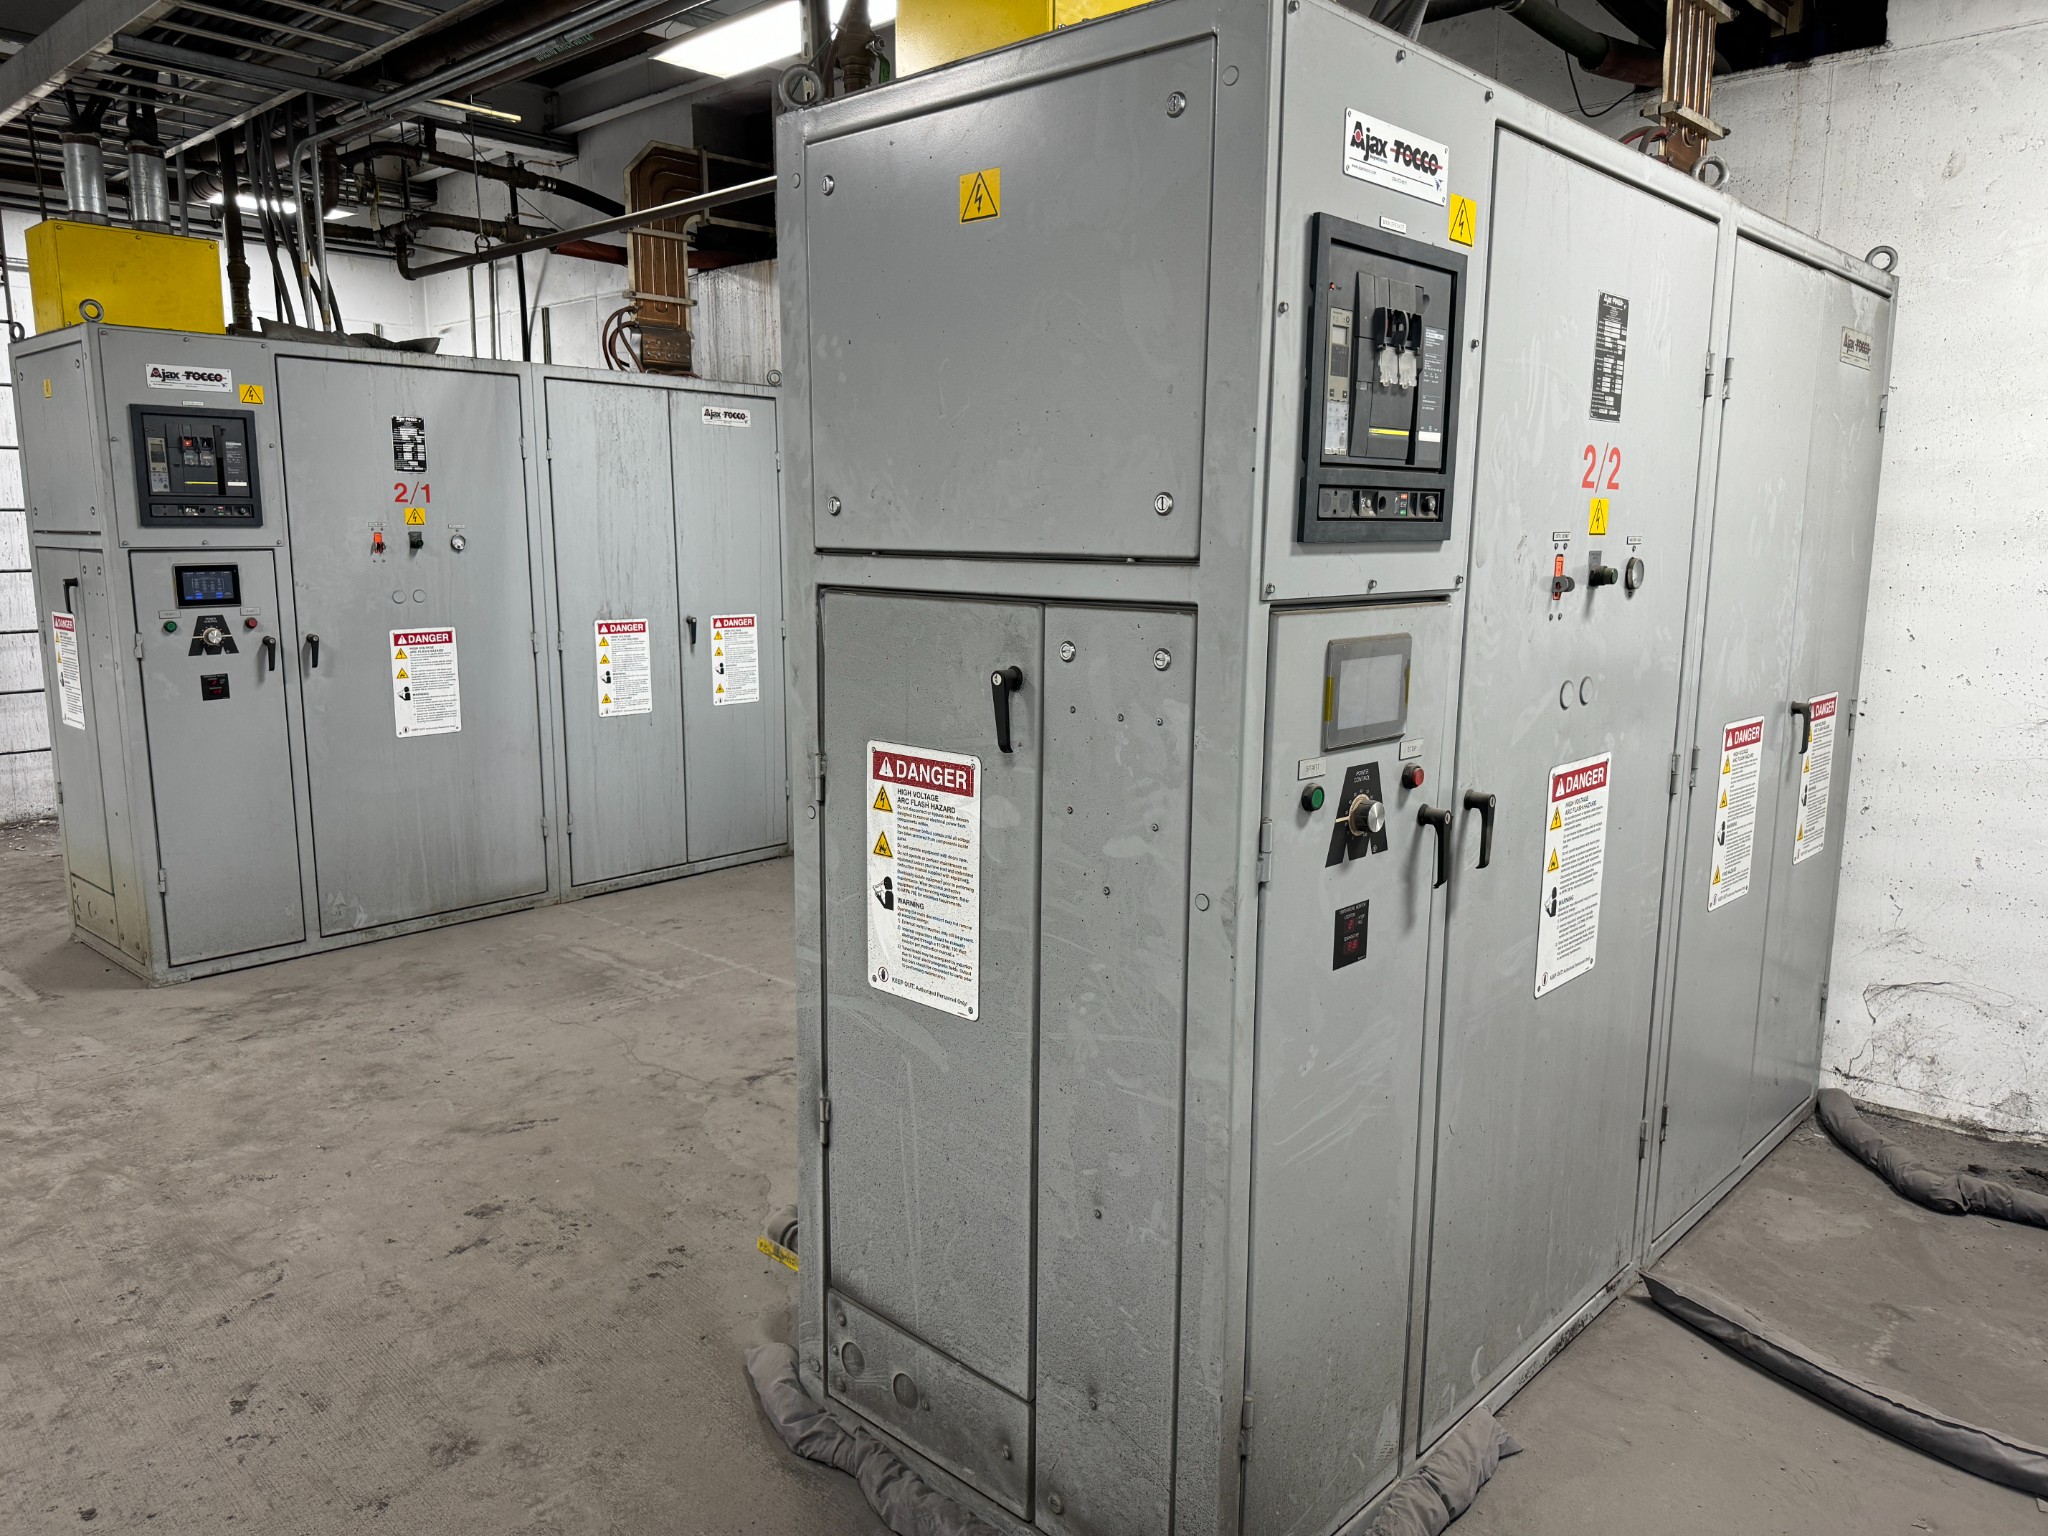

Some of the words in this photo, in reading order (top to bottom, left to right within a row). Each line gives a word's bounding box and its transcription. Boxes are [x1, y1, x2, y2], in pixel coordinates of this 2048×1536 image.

[1350, 120, 1388, 162] Ajax
[1393, 139, 1439, 176] TOCCO
[150, 367, 180, 382] Ajax
[184, 371, 224, 382] TOCCO
[704, 409, 721, 420] Ajax
[723, 411, 746, 420] TOCCO
[1582, 442, 1621, 493] 2/2
[393, 481, 431, 505] 2/1
[610, 623, 643, 632] DANGER
[723, 618, 752, 627] DANGER
[408, 633, 449, 644] DANGER
[1815, 701, 1835, 717] DANGER
[1734, 726, 1760, 744] DANGER
[897, 760, 966, 790] DANGER
[1566, 767, 1604, 793] DANGER
[897, 788, 911, 797] HIGH
[912, 790, 938, 802] VOLTAGE
[910, 798, 929, 809] FLASH
[930, 802, 955, 813] HAZARD
[897, 897, 924, 910] WARNING
